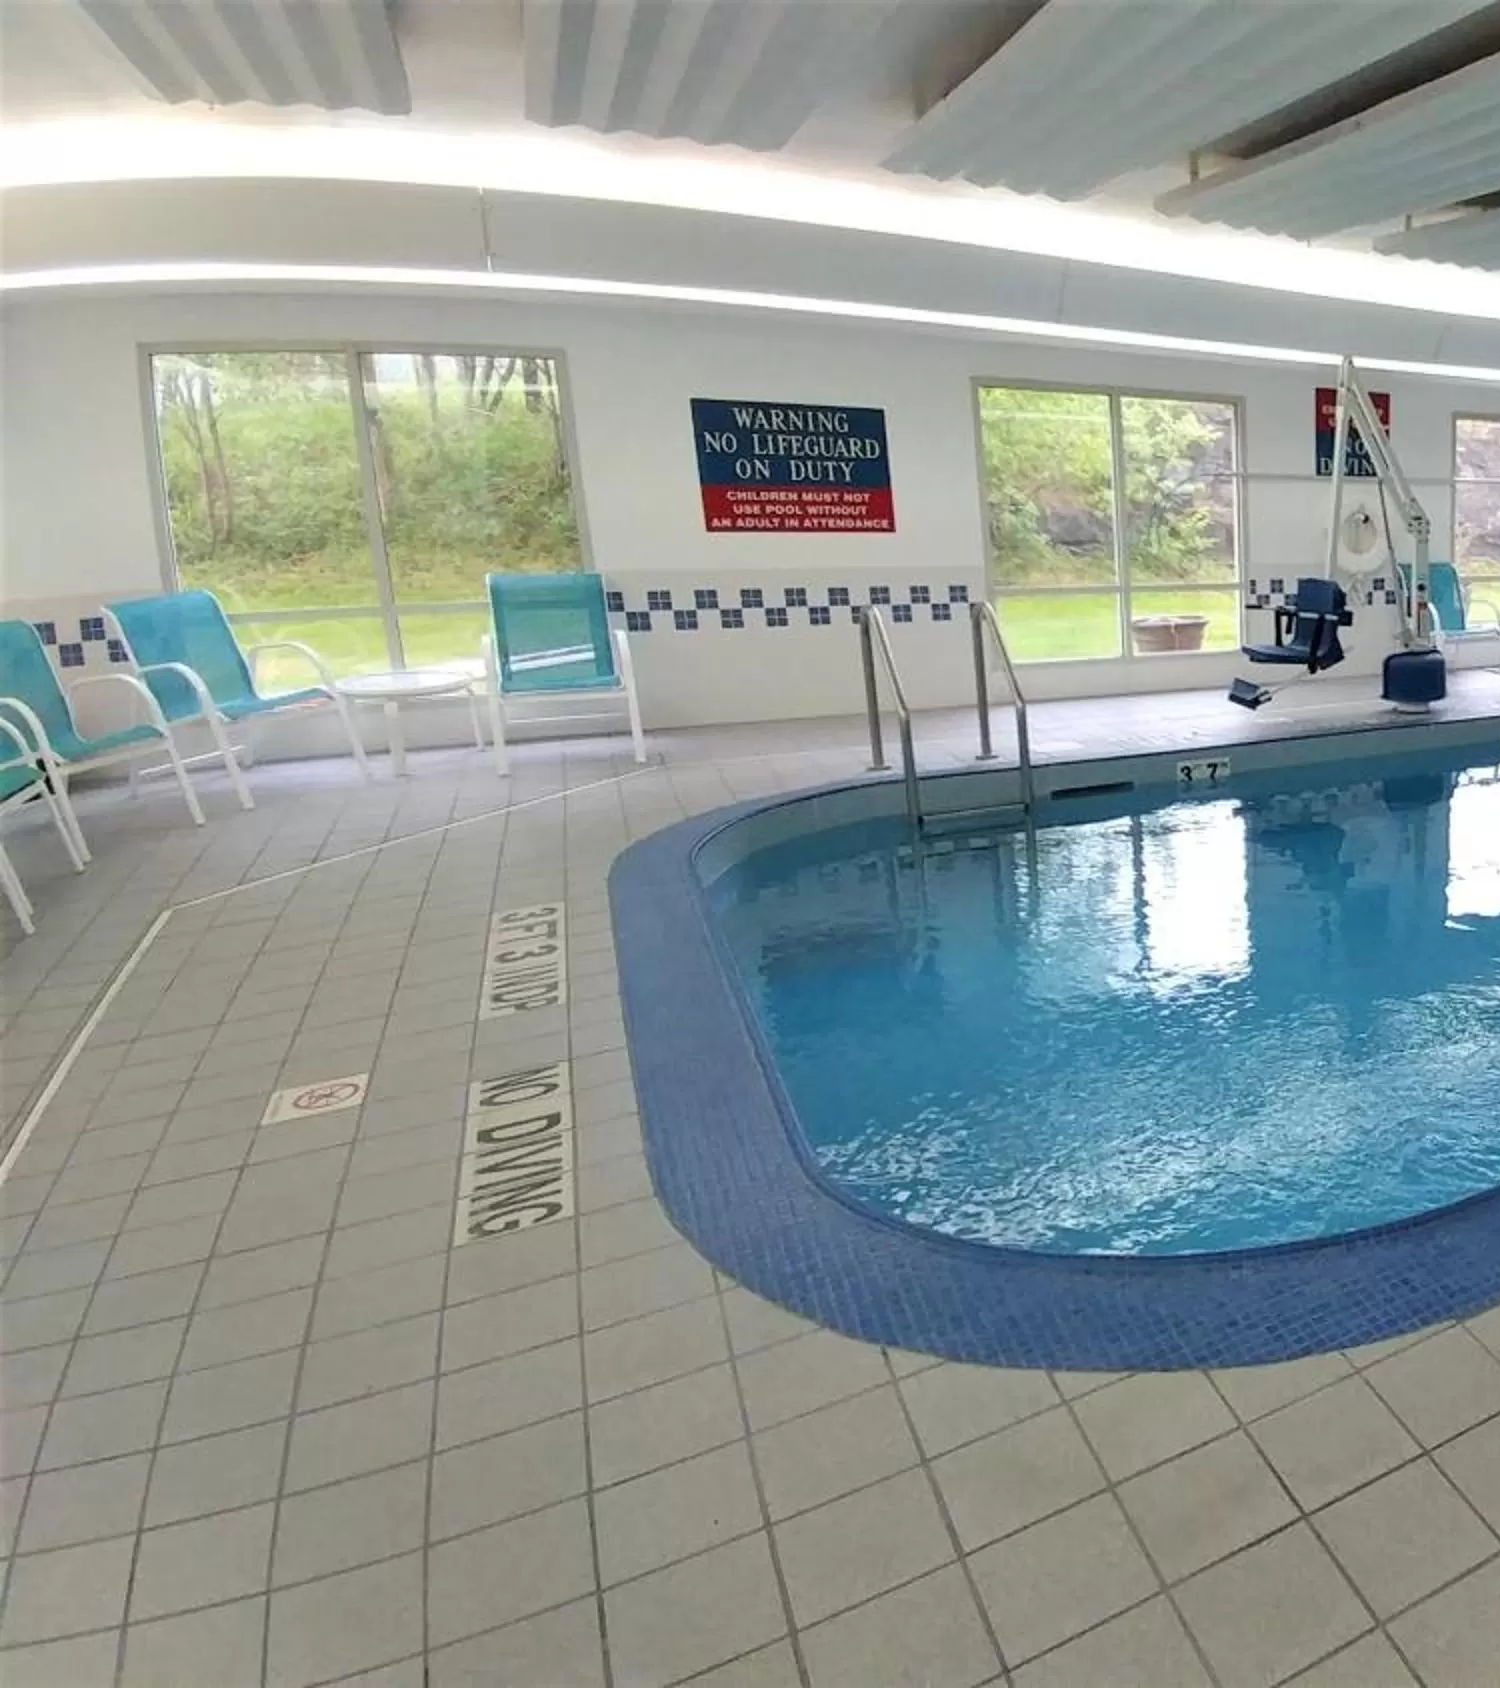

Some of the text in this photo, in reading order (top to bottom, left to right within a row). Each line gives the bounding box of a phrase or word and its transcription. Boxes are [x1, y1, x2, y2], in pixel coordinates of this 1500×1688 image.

[733, 408, 848, 432] WARNING
[704, 432, 880, 459] NO LIFEGUARD
[736, 459, 855, 481] ON DUTY
[726, 491, 871, 503] CHILDREN MUST NOT
[733, 504, 868, 515] USE POOL WITHOUT
[711, 518, 890, 529] AN ADULT IN ATTENDANCE
[467, 1064, 563, 1236] NO DIVING
